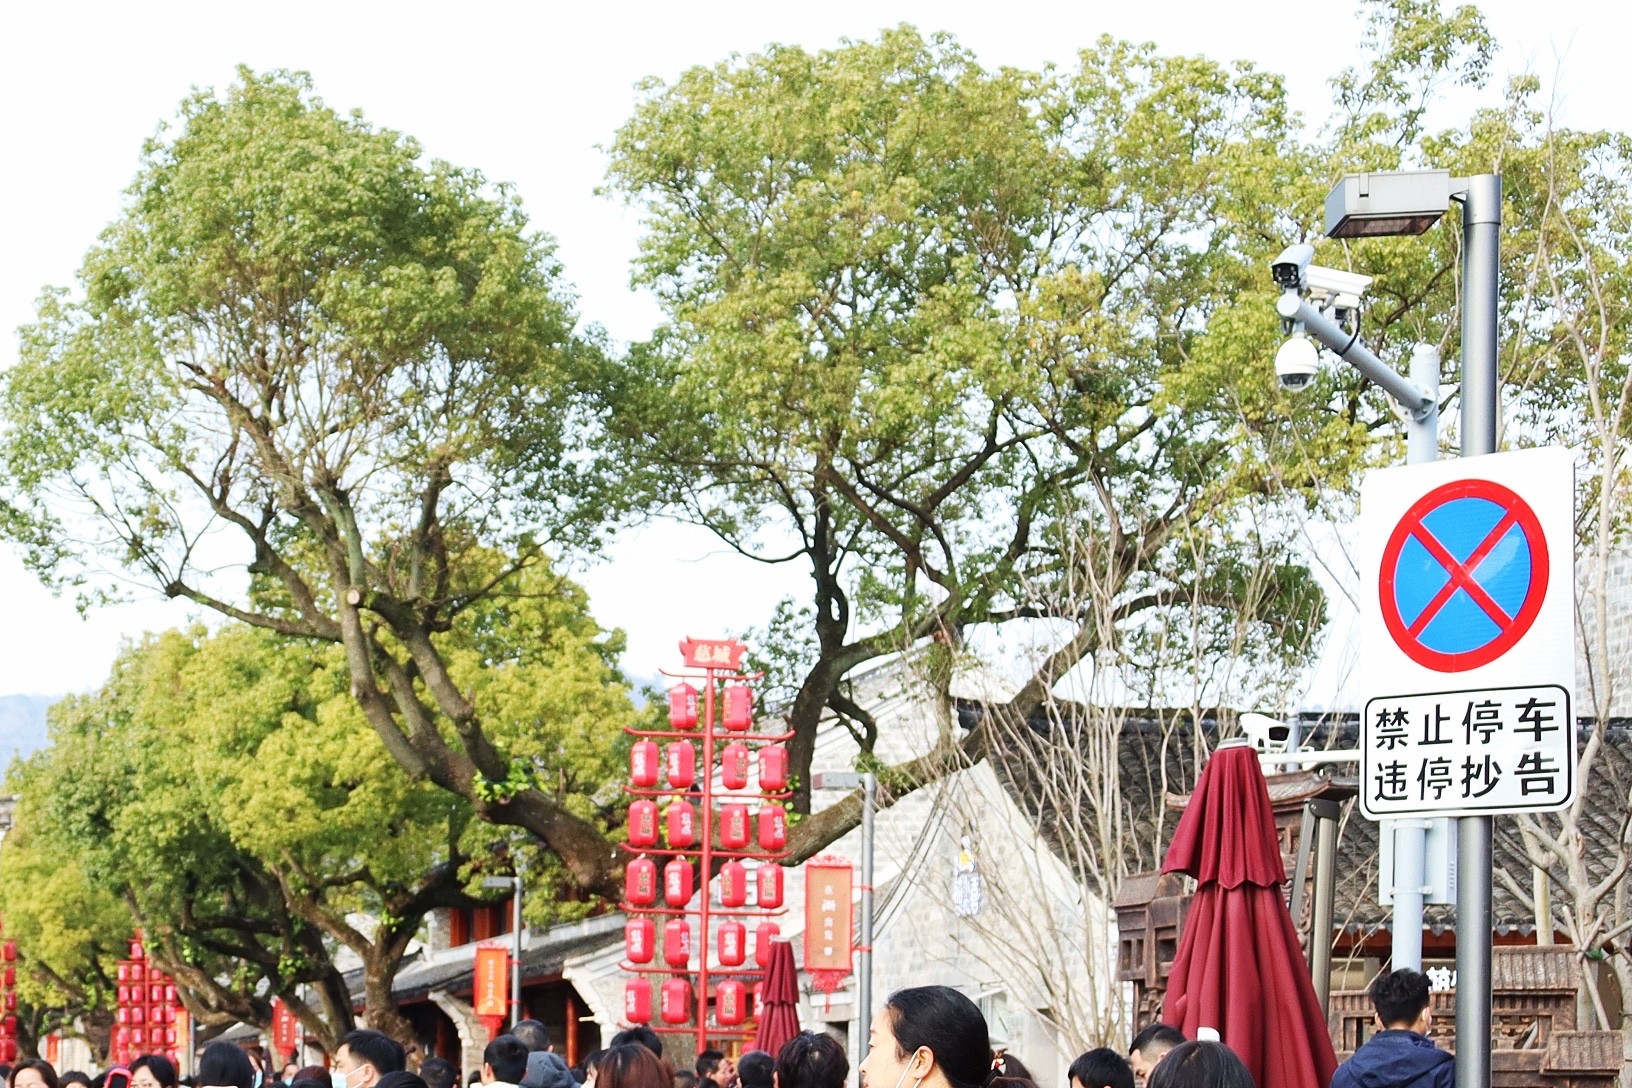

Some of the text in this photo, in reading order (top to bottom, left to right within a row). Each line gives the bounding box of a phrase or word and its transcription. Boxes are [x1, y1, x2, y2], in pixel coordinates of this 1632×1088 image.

[1375, 697, 1559, 750] 禁止停车
[1374, 751, 1560, 801] 违停抄告
